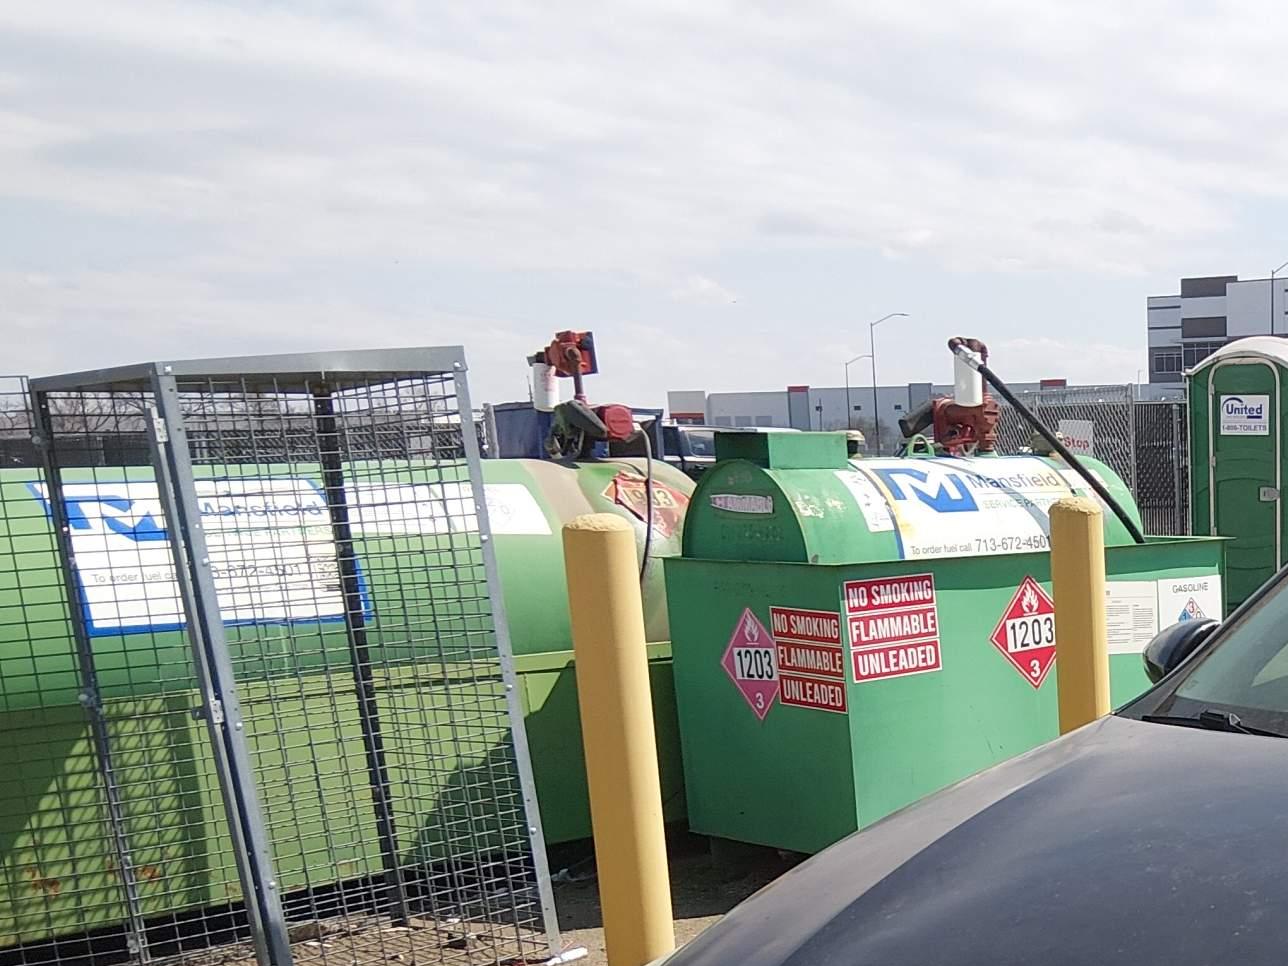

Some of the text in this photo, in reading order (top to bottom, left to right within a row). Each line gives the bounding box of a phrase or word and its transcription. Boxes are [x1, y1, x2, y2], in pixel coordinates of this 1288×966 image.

[1225, 403, 1263, 415] United
[1064, 436, 1089, 450] Stop
[966, 472, 1061, 489] Mansfield
[981, 498, 1023, 510] SERVICE
[910, 535, 1052, 555] To order fuel call 713-672-4501
[92, 573, 105, 583] To
[1172, 582, 1209, 594] GASOLINE
[848, 579, 932, 608] NO SMOKING
[1188, 601, 1196, 614] 3
[773, 614, 839, 640] NO SMOKING
[851, 611, 936, 643] FLAMMABLE
[1010, 616, 1054, 650] 1203
[736, 649, 774, 680] 1203
[778, 645, 843, 673] FLAMMABLE
[857, 645, 936, 677] UNLEADED
[1030, 658, 1041, 678] 3
[755, 692, 765, 709] 3
[783, 679, 843, 707] UNLEADED
